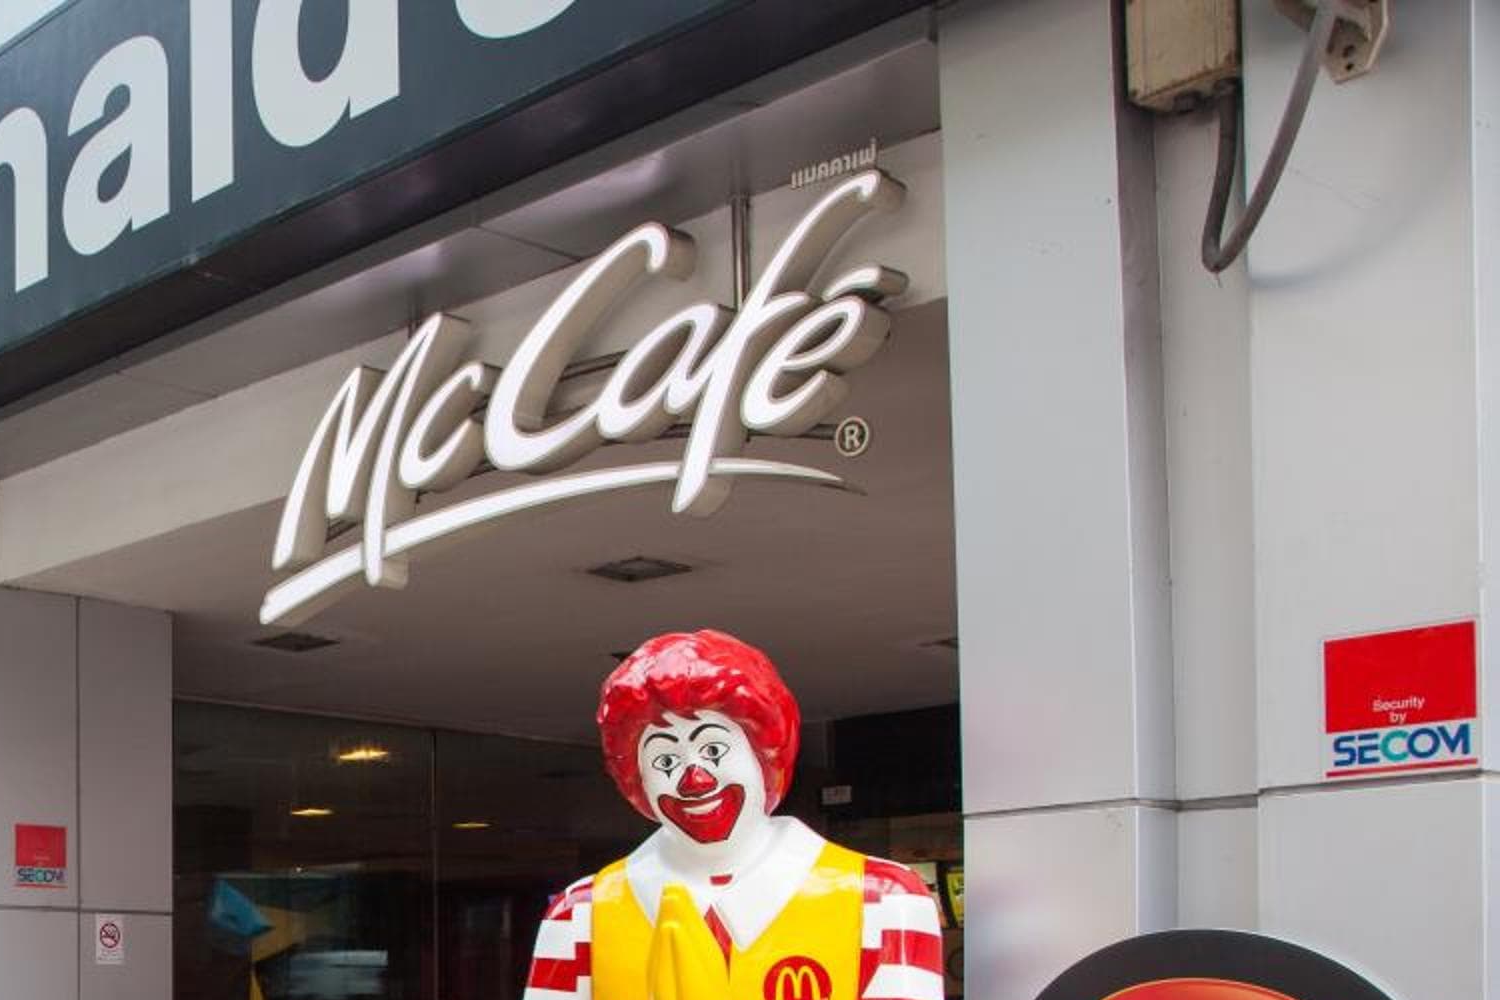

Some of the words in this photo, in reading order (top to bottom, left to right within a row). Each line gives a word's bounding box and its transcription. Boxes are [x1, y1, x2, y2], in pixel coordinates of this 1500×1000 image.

[262, 170, 905, 610] McCafé
[1372, 696, 1425, 711] Security
[1389, 712, 1407, 725] by
[1332, 723, 1471, 767] SECOM
